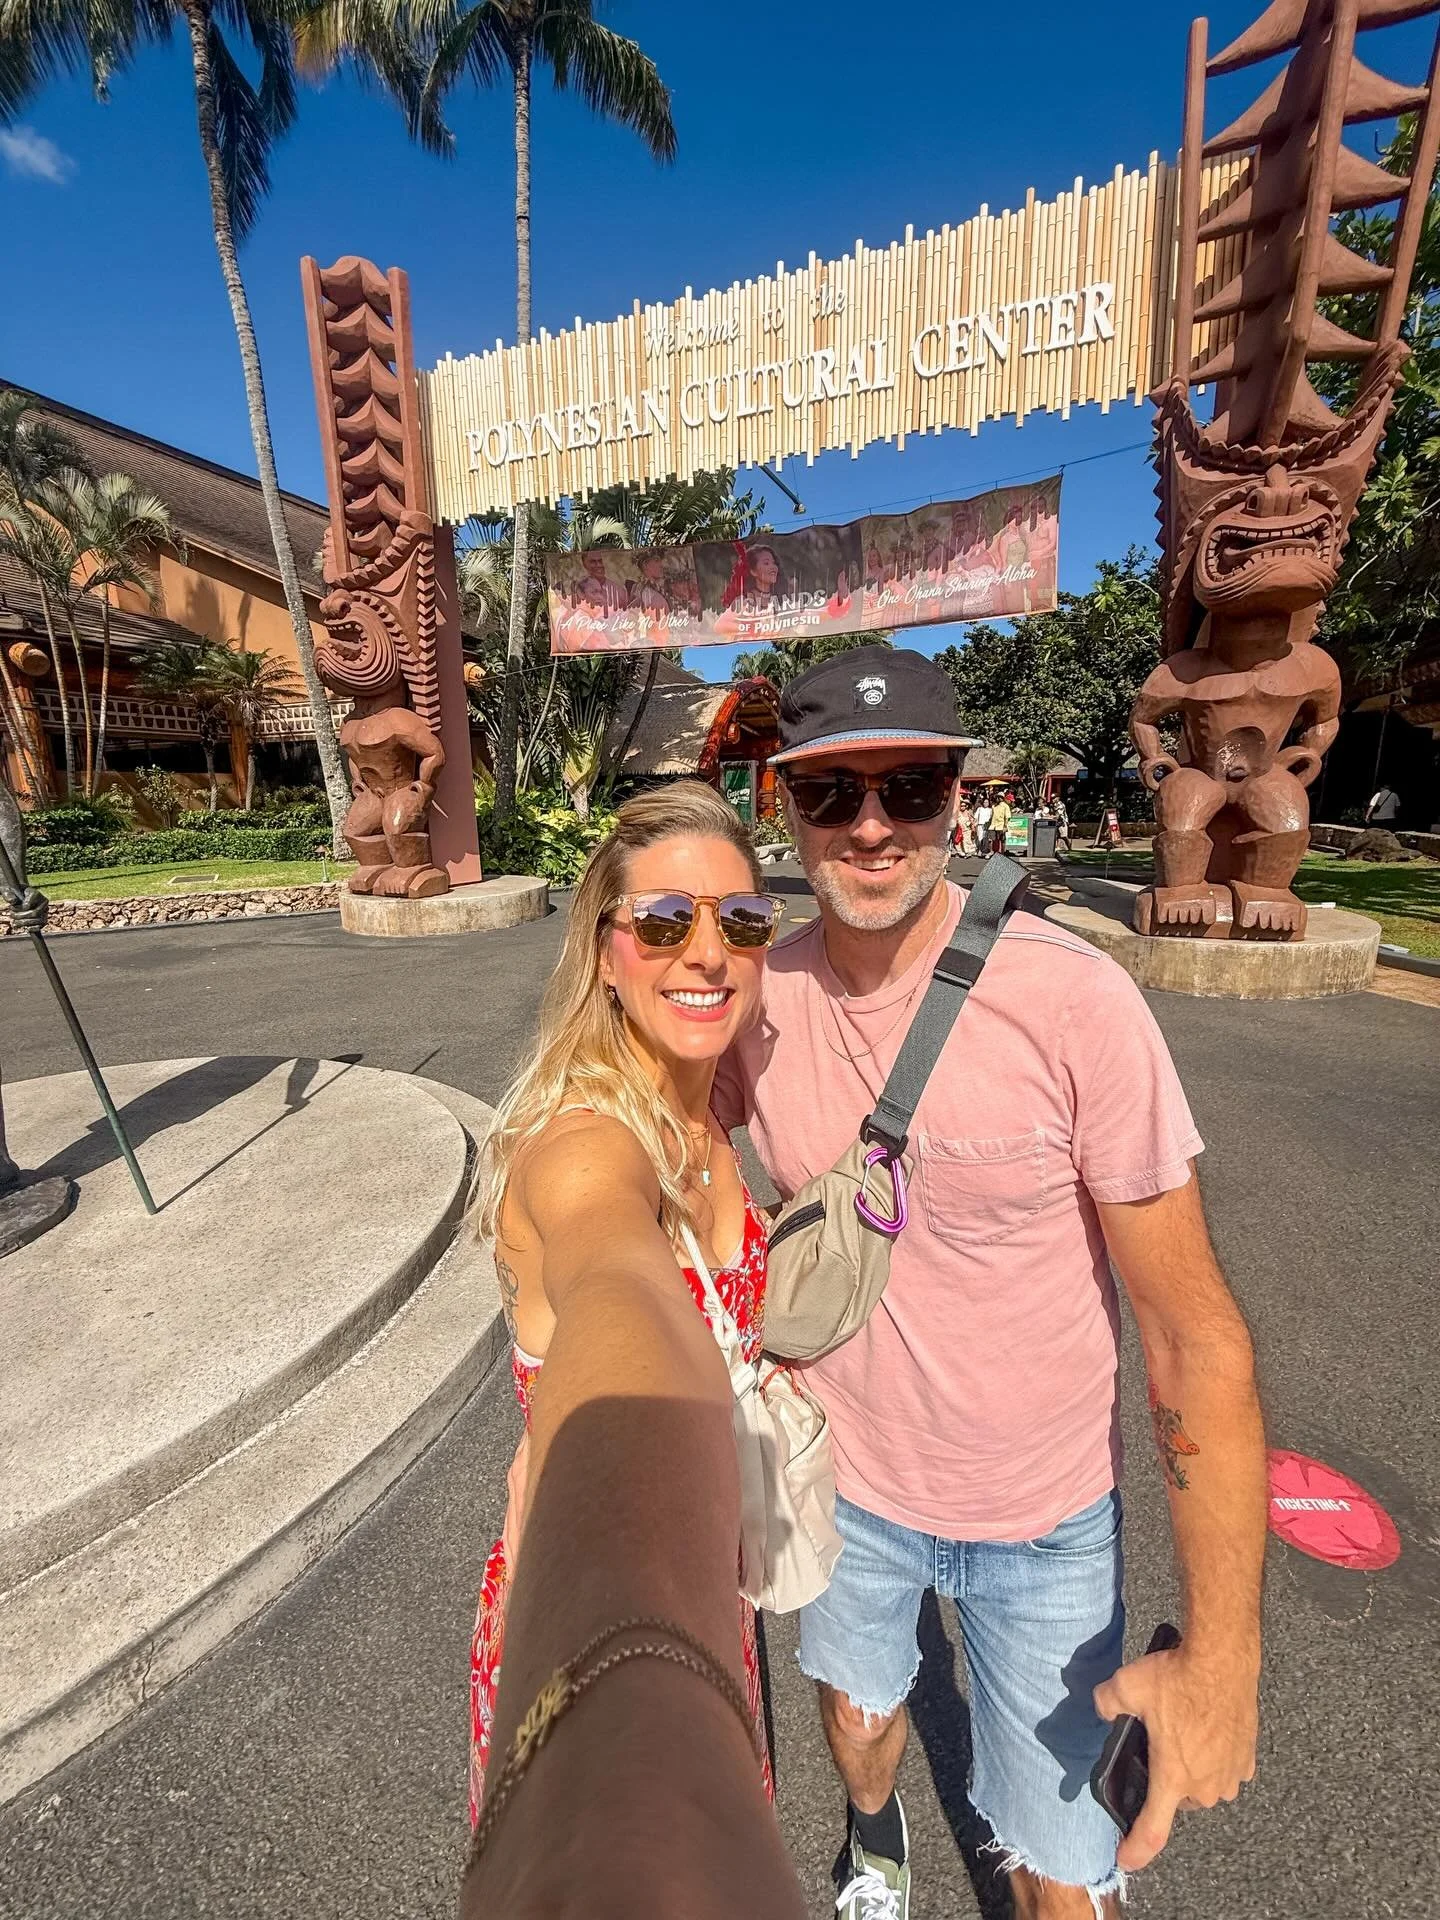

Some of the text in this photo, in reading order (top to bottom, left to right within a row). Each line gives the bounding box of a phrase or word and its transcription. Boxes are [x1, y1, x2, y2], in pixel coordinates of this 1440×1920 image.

[644, 283, 848, 361] Welcome to the
[466, 282, 1116, 473] POLYNESIAN CULTURAL CENTER
[877, 563, 1037, 608] One Ohana Sharing Aloha
[735, 589, 827, 617] ISLANDS
[561, 612, 690, 632] A Place Like No Other
[738, 615, 820, 633] OF Polynesia
[1272, 1497, 1341, 1512] TICKETING
